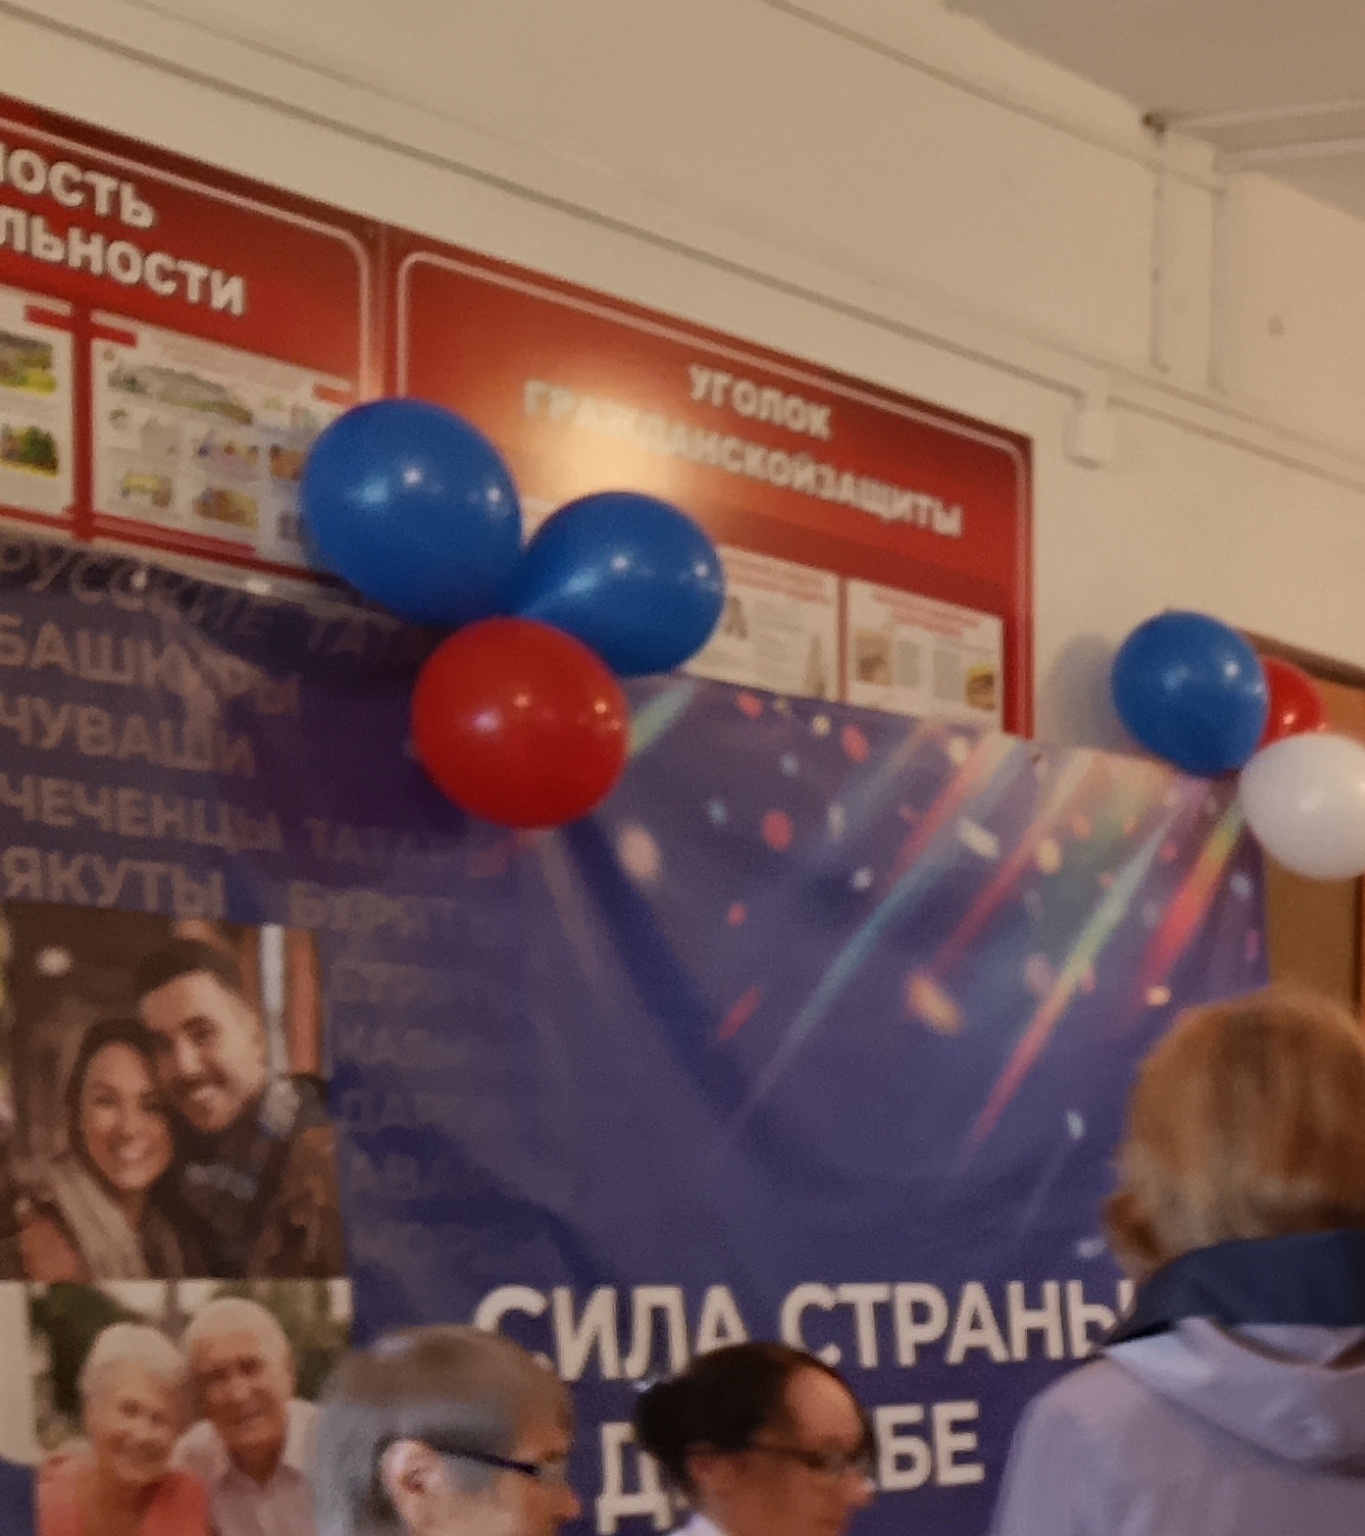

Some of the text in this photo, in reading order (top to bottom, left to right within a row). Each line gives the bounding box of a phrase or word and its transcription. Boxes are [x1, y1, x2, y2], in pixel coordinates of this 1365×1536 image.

[0, 141, 157, 229] ОСТЬ
[688, 362, 834, 442] УГОЛОК
[0, 688, 257, 778] ЧУВАШИ
[0, 770, 284, 852] ЧЕЧЕНЦЫ
[2, 845, 227, 919] ЯКУТЫ
[473, 1280, 748, 1382] СИЛА
